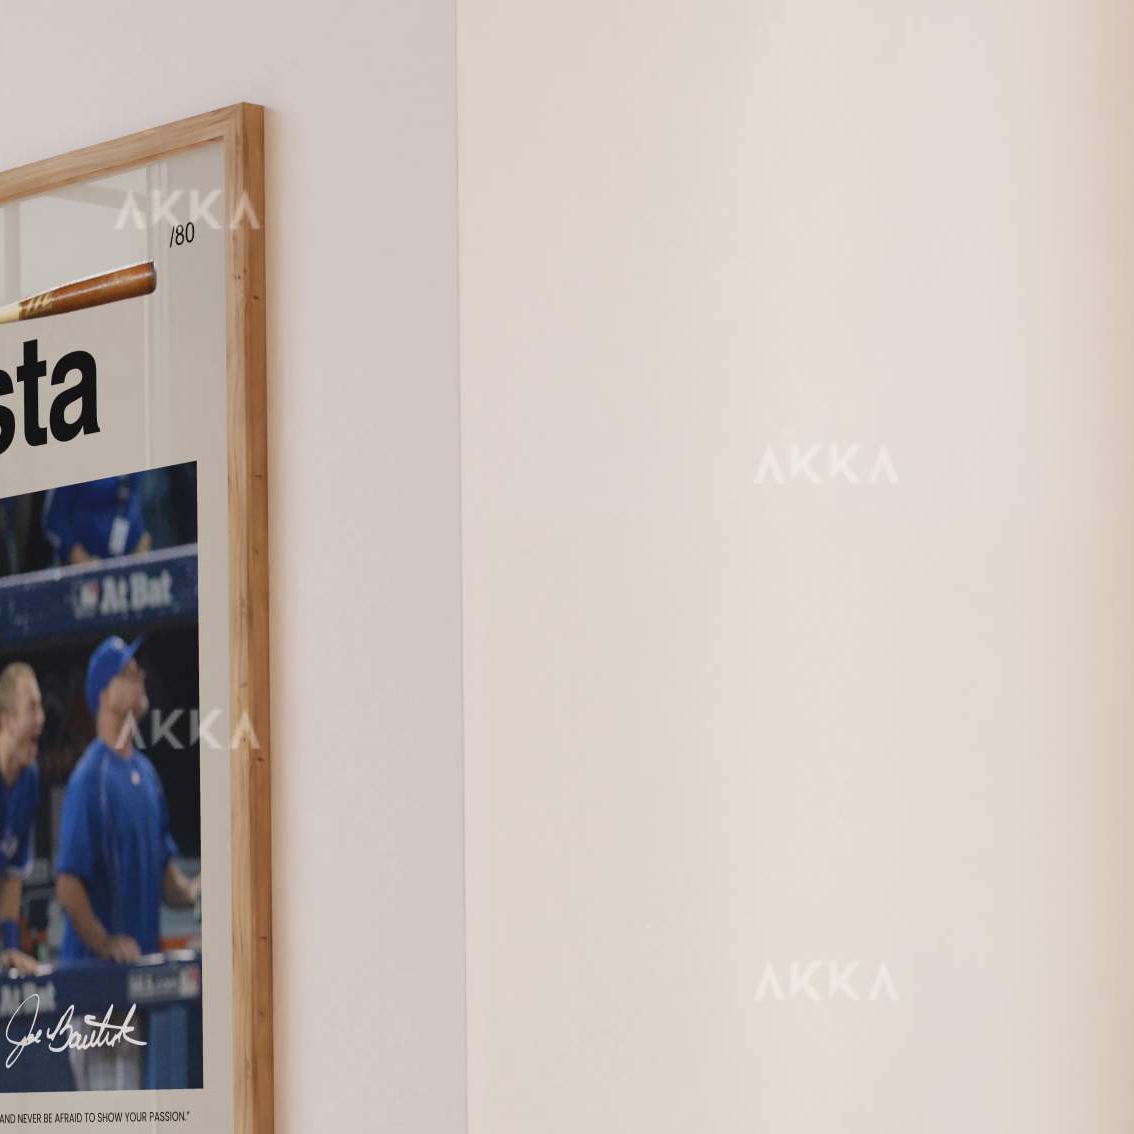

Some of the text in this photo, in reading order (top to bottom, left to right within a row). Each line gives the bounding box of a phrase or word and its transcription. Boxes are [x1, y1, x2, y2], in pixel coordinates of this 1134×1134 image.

[169, 222, 195, 248] /80
[0, 1113, 16, 1123] AND
[17, 1113, 41, 1123] NEVER
[43, 1112, 52, 1123] BE
[54, 1112, 82, 1122] AFRAID
[84, 1112, 95, 1122] TO
[97, 1112, 122, 1122] SHOW
[124, 1111, 146, 1122] YOUR
[149, 1110, 189, 1121] PASSION.”
